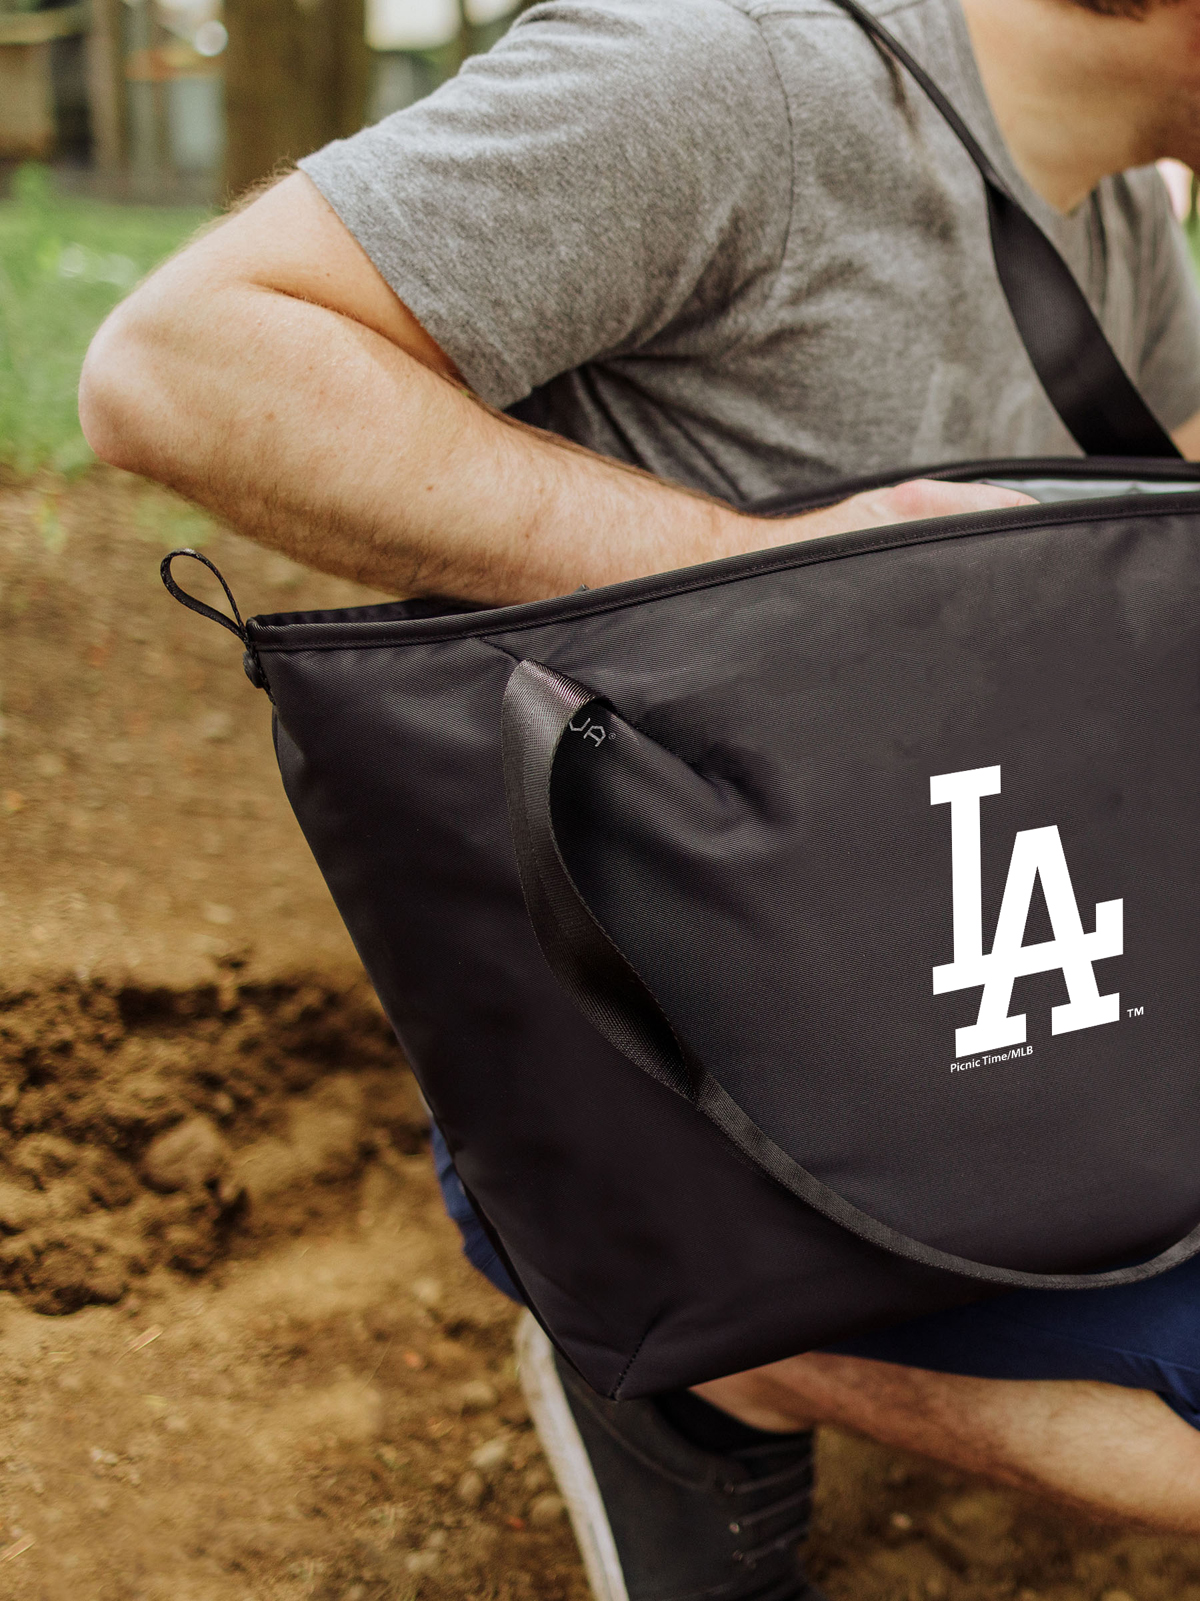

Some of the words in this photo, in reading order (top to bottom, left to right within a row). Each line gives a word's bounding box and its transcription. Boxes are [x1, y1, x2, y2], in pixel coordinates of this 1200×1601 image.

[930, 765, 1124, 1059] LA
[1126, 1006, 1144, 1018] TM
[950, 1059, 981, 1073] Picnic
[982, 1045, 1034, 1066] Time/MLB
